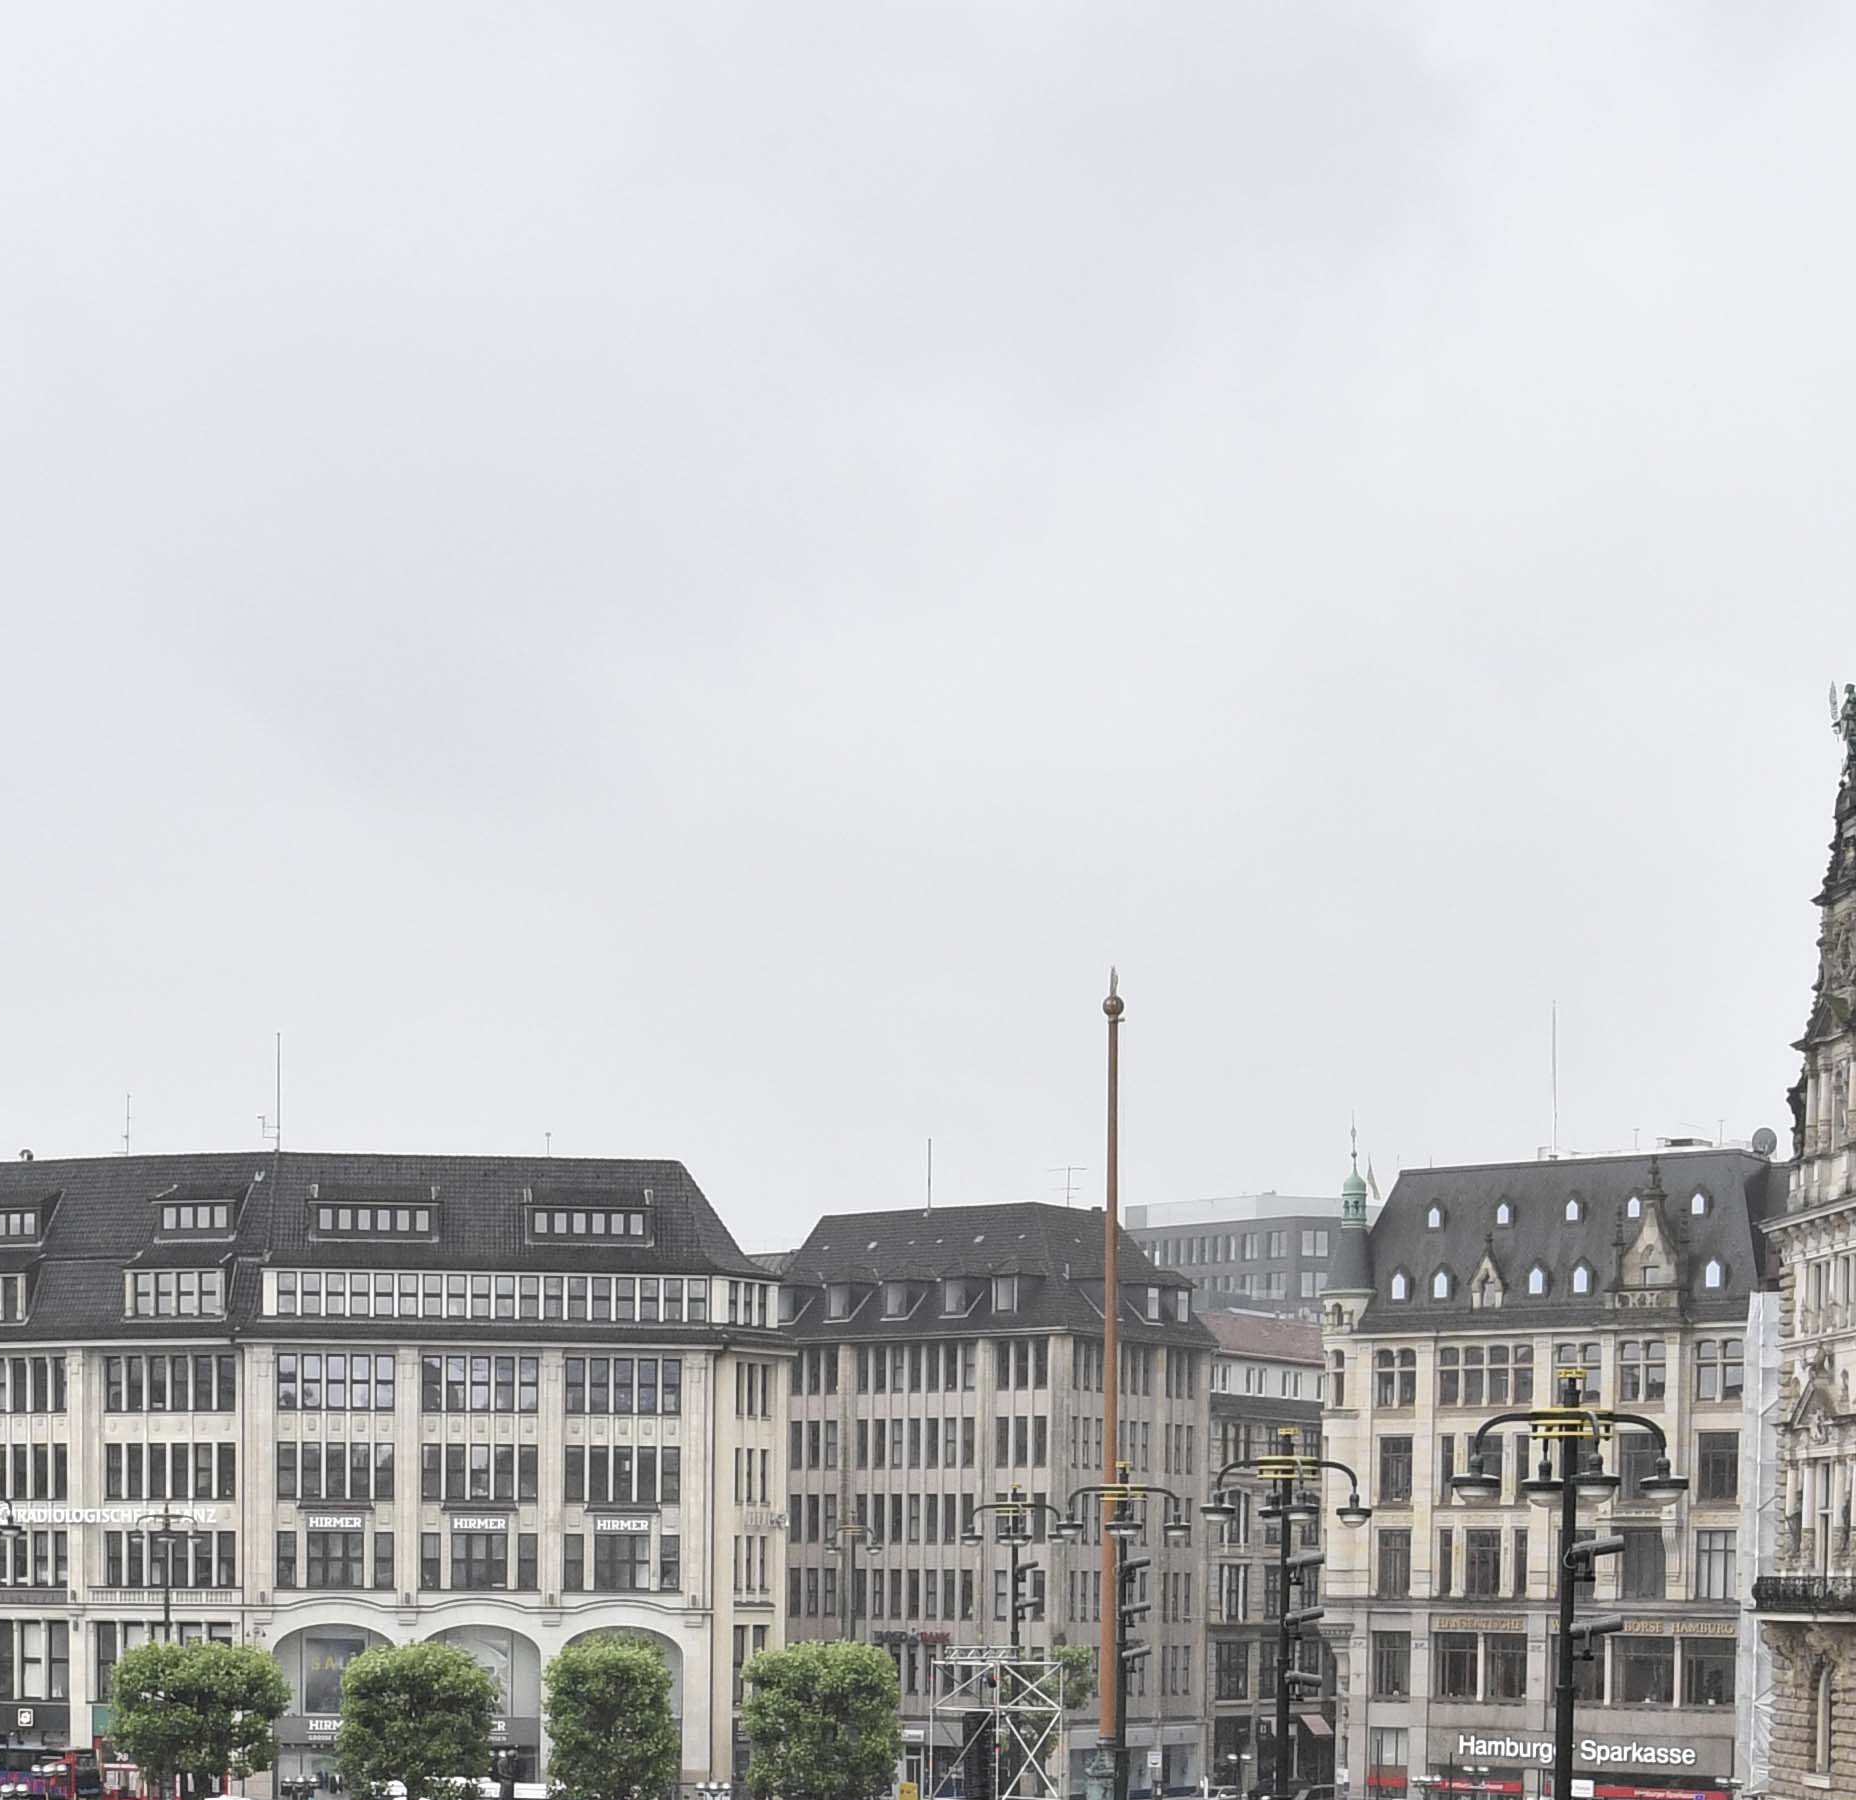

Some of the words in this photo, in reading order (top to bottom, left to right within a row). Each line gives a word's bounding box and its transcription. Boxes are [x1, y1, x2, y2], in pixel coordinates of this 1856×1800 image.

[309, 1517, 362, 1528] HIRMER
[453, 1518, 506, 1530] HIRMER
[596, 1519, 649, 1531] HIRMER
[1672, 1621, 1734, 1634] HAMBURG
[309, 1720, 344, 1731] HIRM
[1458, 1734, 1558, 1764] Hamburg
[1580, 1739, 1697, 1765] Sparkasse
